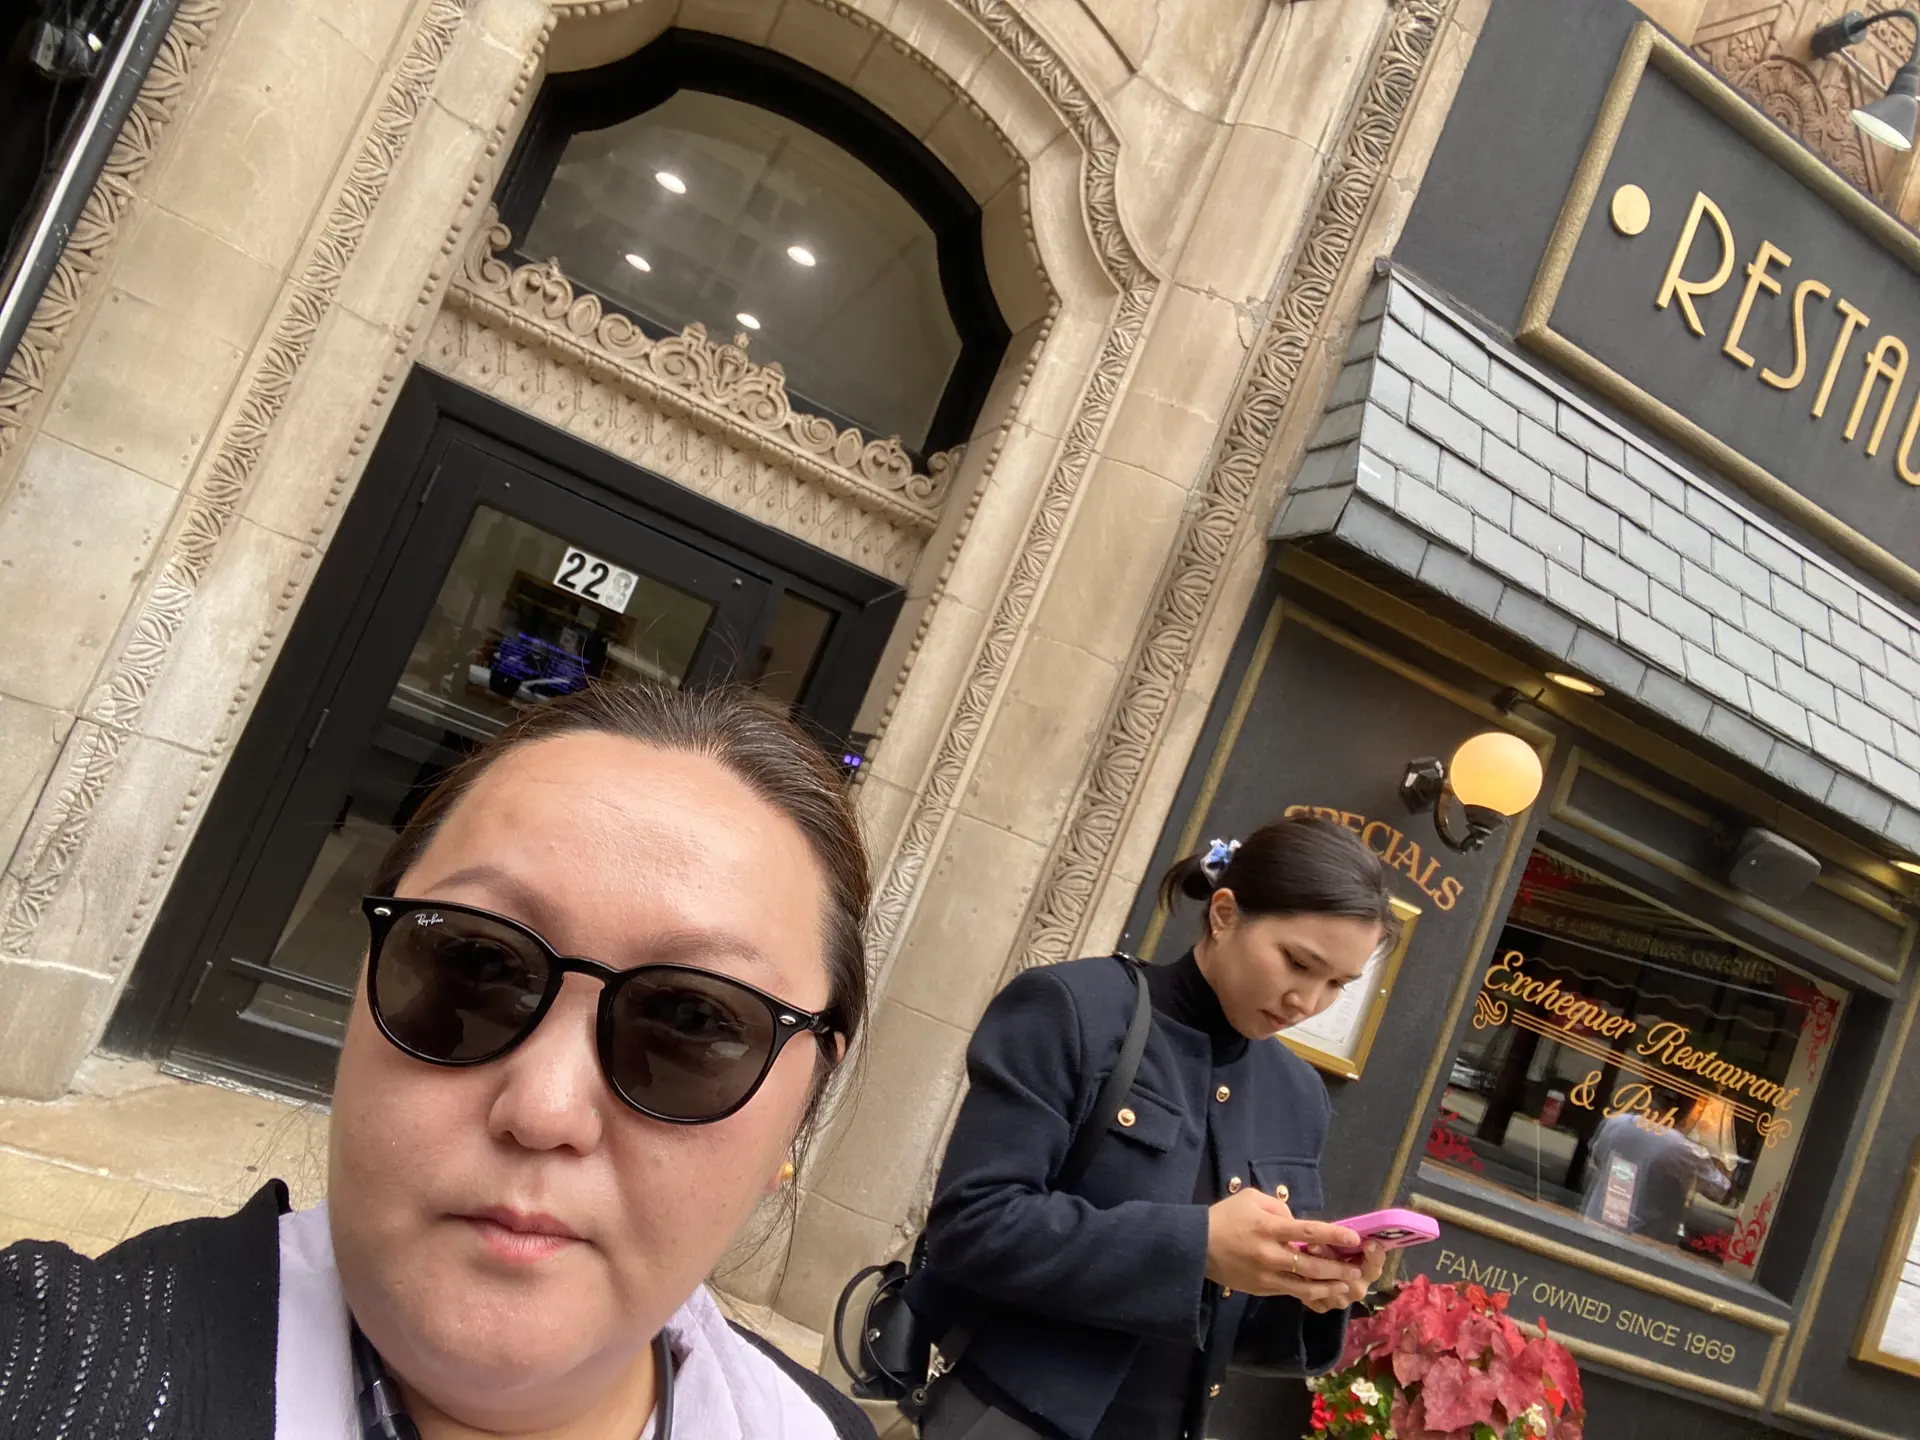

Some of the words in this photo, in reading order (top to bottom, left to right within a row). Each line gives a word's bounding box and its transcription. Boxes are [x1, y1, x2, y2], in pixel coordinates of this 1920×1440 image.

[414, 912, 443, 927] Ray-Ban
[1484, 950, 1636, 1040] Exchequer
[1636, 1021, 1800, 1111] Restaurant
[1569, 1070, 1602, 1110] &
[1602, 1081, 1680, 1136] Pub
[1435, 1249, 1528, 1295] FAMILY
[1532, 1282, 1611, 1325] OWNED
[1615, 1310, 1680, 1347] SINCE
[1683, 1331, 1736, 1365] 1969
